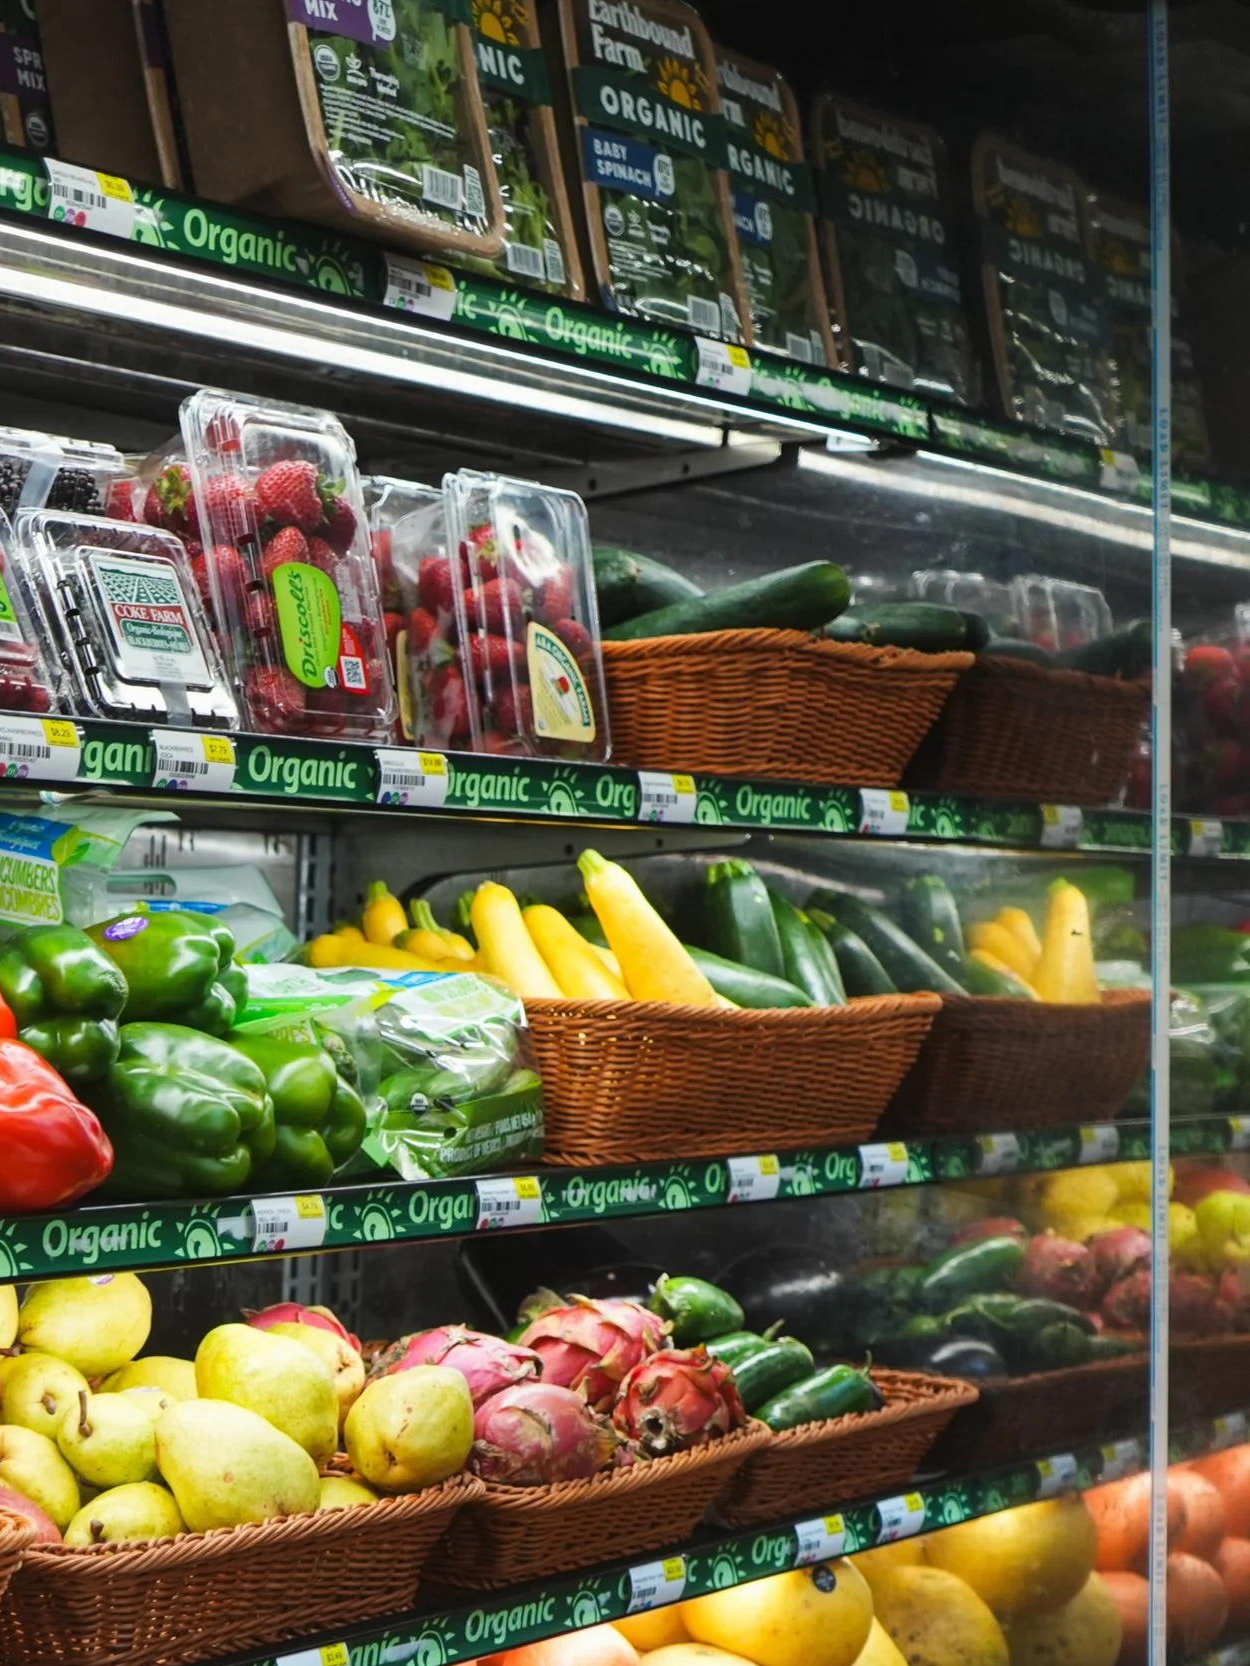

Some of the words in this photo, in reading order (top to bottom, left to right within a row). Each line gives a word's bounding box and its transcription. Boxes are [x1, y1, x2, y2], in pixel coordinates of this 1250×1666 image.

[588, 0, 695, 60] Earthbound
[590, 23, 648, 74] Farm
[13, 46, 43, 70] SPR
[718, 60, 783, 113] rthbound
[600, 85, 707, 149] ORGANIC
[593, 138, 627, 161] BABY
[727, 144, 795, 195] RGANIC
[596, 162, 652, 188] SPINACH
[183, 209, 297, 272] Organic
[544, 306, 632, 361] Organic
[114, 603, 150, 620] COKE
[150, 608, 184, 625] FARM
[287, 567, 318, 678] Driscoll's
[248, 744, 357, 794] Organic
[736, 784, 810, 826] Organic
[408, 1189, 474, 1229] Orga
[567, 1169, 652, 1212] Organic
[42, 1219, 163, 1265] Organic
[464, 1590, 554, 1645] Organic
